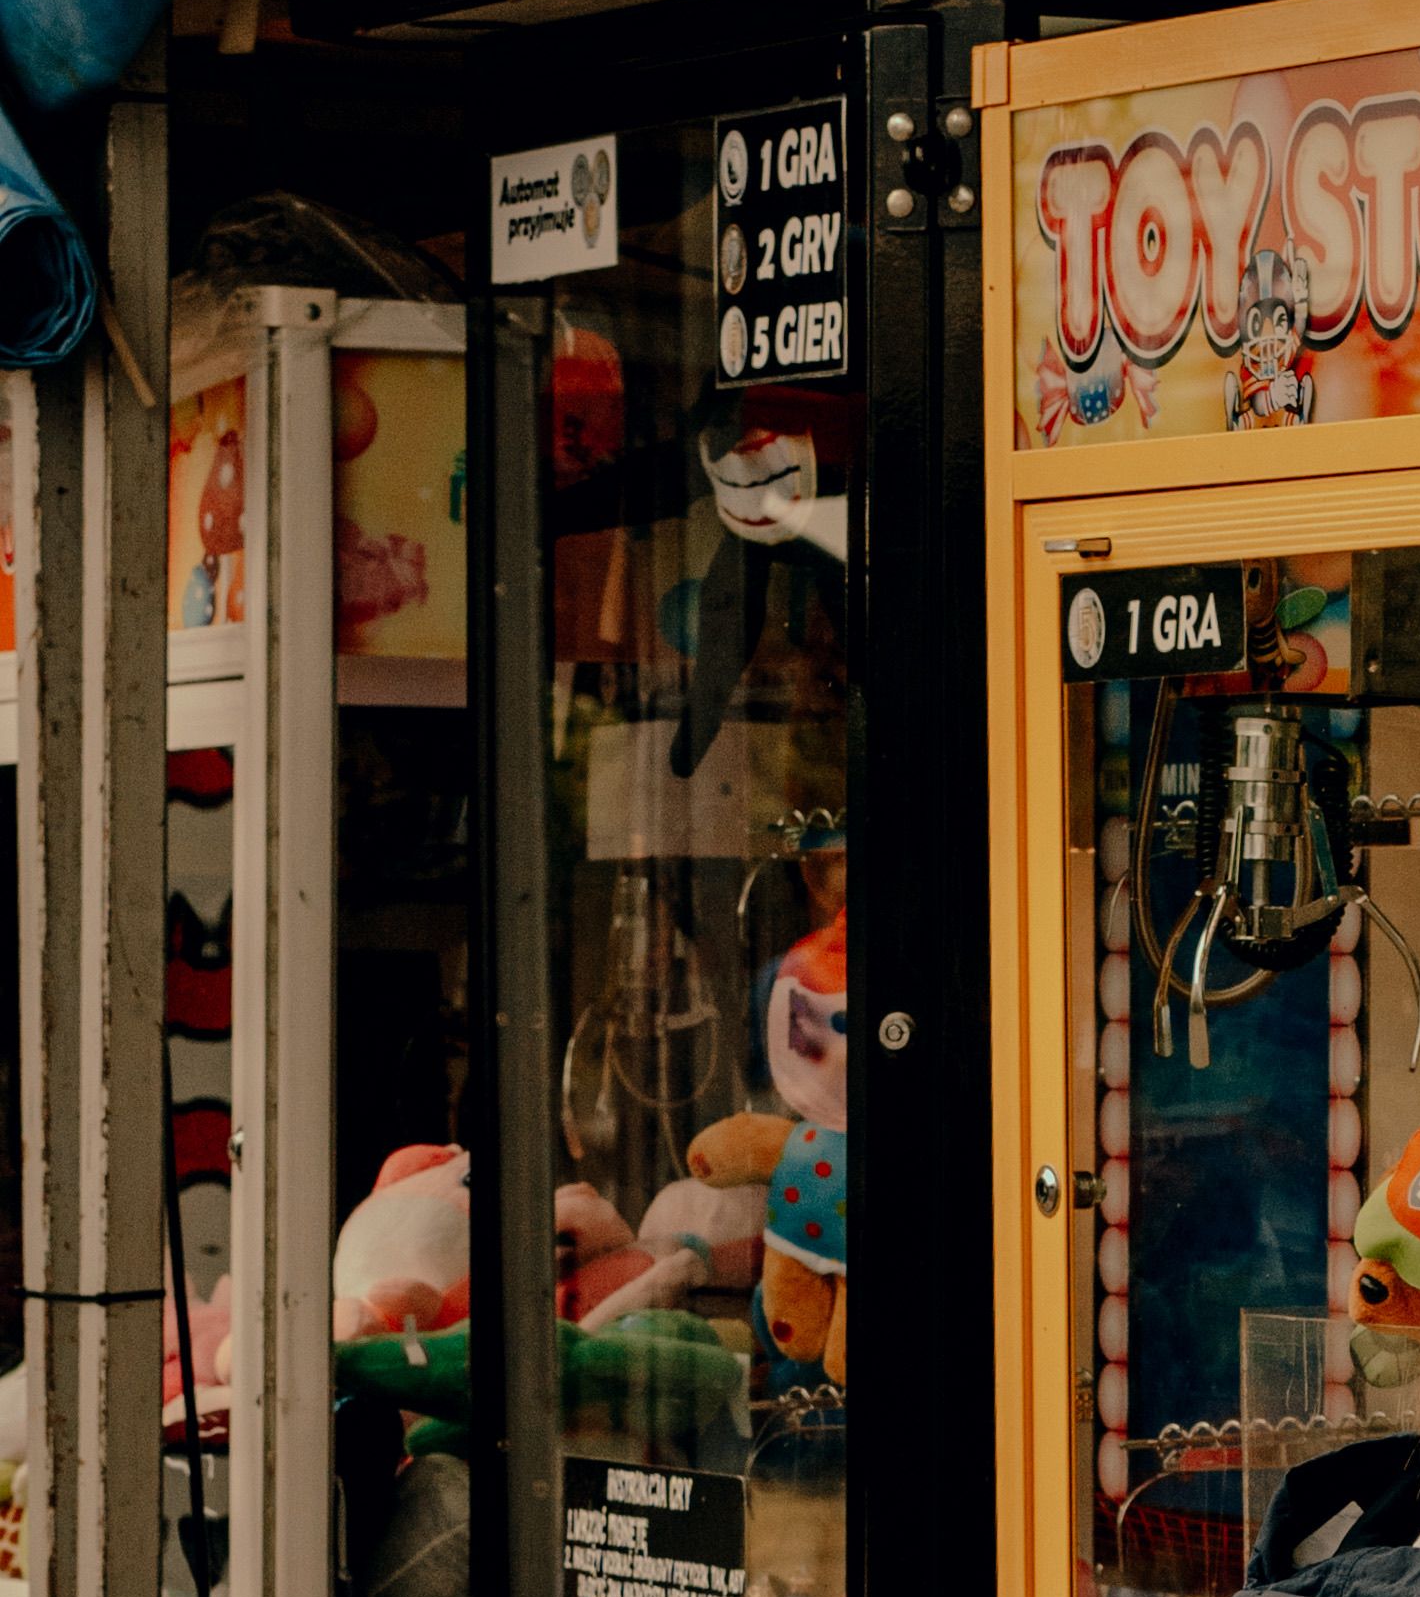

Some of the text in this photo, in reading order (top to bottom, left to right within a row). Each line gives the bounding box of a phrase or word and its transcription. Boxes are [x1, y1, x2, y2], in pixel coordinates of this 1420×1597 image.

[499, 171, 560, 207] Automat
[760, 122, 837, 191] 1 GRA
[508, 203, 576, 245] przyjmuje
[756, 211, 842, 281] 2 GRY
[1036, 120, 1275, 373] TOY
[751, 301, 844, 370] 5 GIER
[1127, 599, 1141, 655] 1
[1152, 592, 1222, 653] GRA
